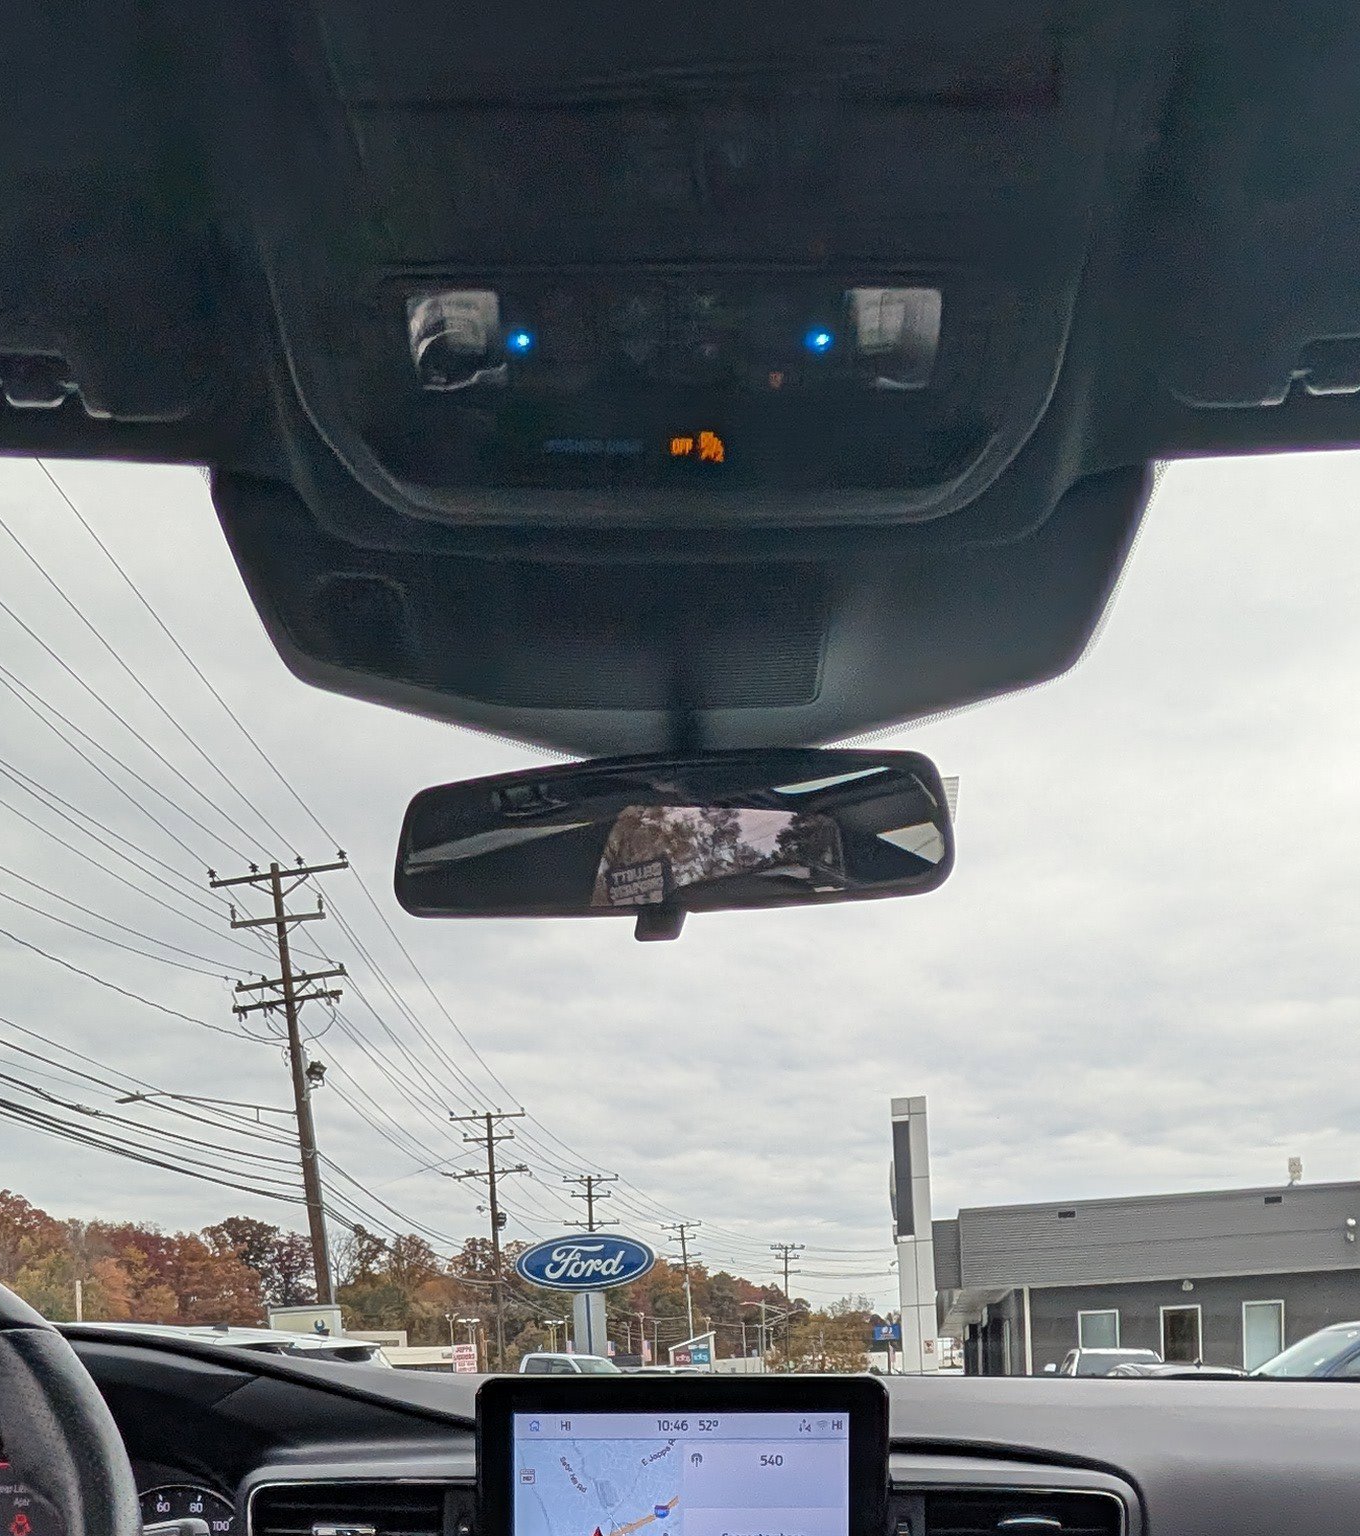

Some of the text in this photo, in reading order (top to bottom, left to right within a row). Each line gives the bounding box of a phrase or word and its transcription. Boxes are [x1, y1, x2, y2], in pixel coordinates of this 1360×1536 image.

[544, 1244, 626, 1279] Ford
[657, 1419, 689, 1431] 10:46
[760, 1455, 784, 1467] 540
[156, 1502, 171, 1513] 60
[189, 1502, 204, 1513] 80
[213, 1520, 230, 1532] 100
